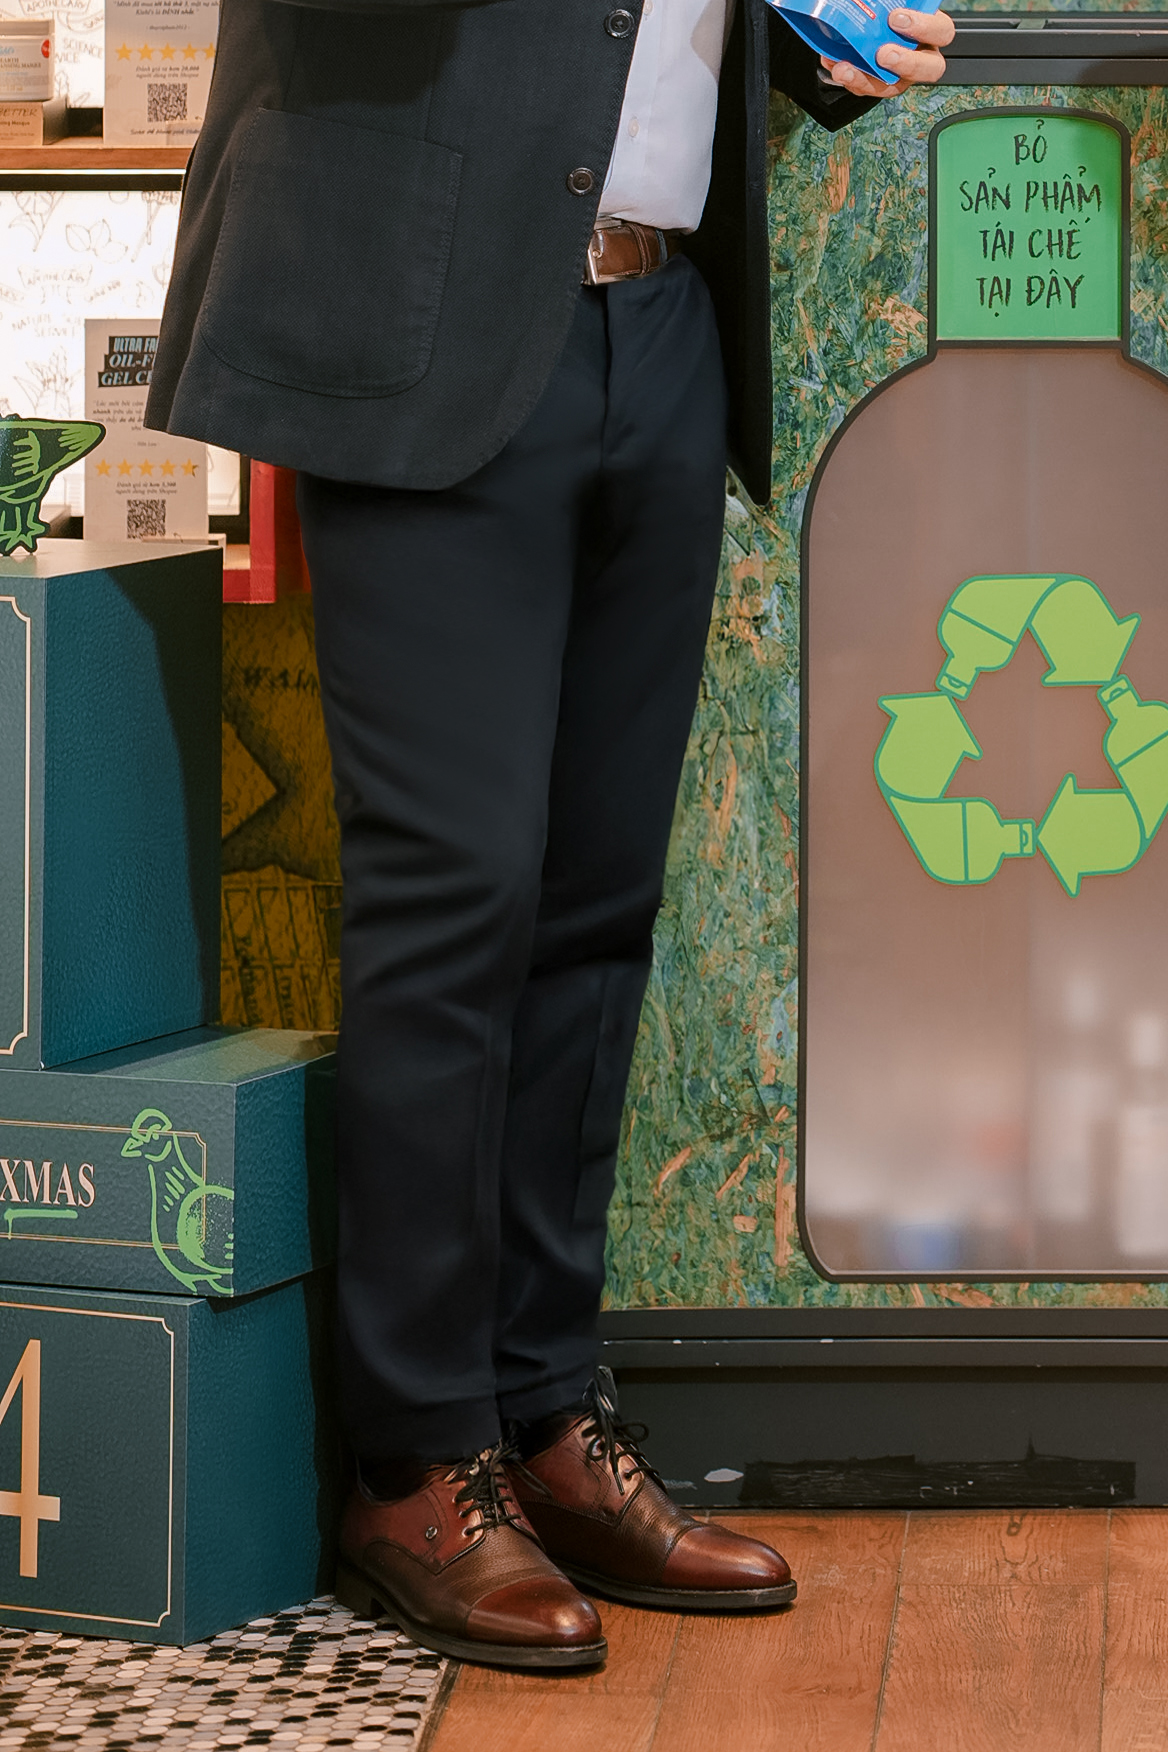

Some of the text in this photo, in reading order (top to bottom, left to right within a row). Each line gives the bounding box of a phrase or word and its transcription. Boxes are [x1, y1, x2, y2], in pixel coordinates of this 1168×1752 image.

[1013, 119, 1049, 165] BỎ
[959, 166, 1102, 214] SẢN PHẨM
[979, 217, 1092, 261] TÁI CHẾ
[975, 268, 1086, 318] TẠI ĐÂY
[101, 372, 132, 386] GEL
[0, 1159, 96, 1208] XMAS
